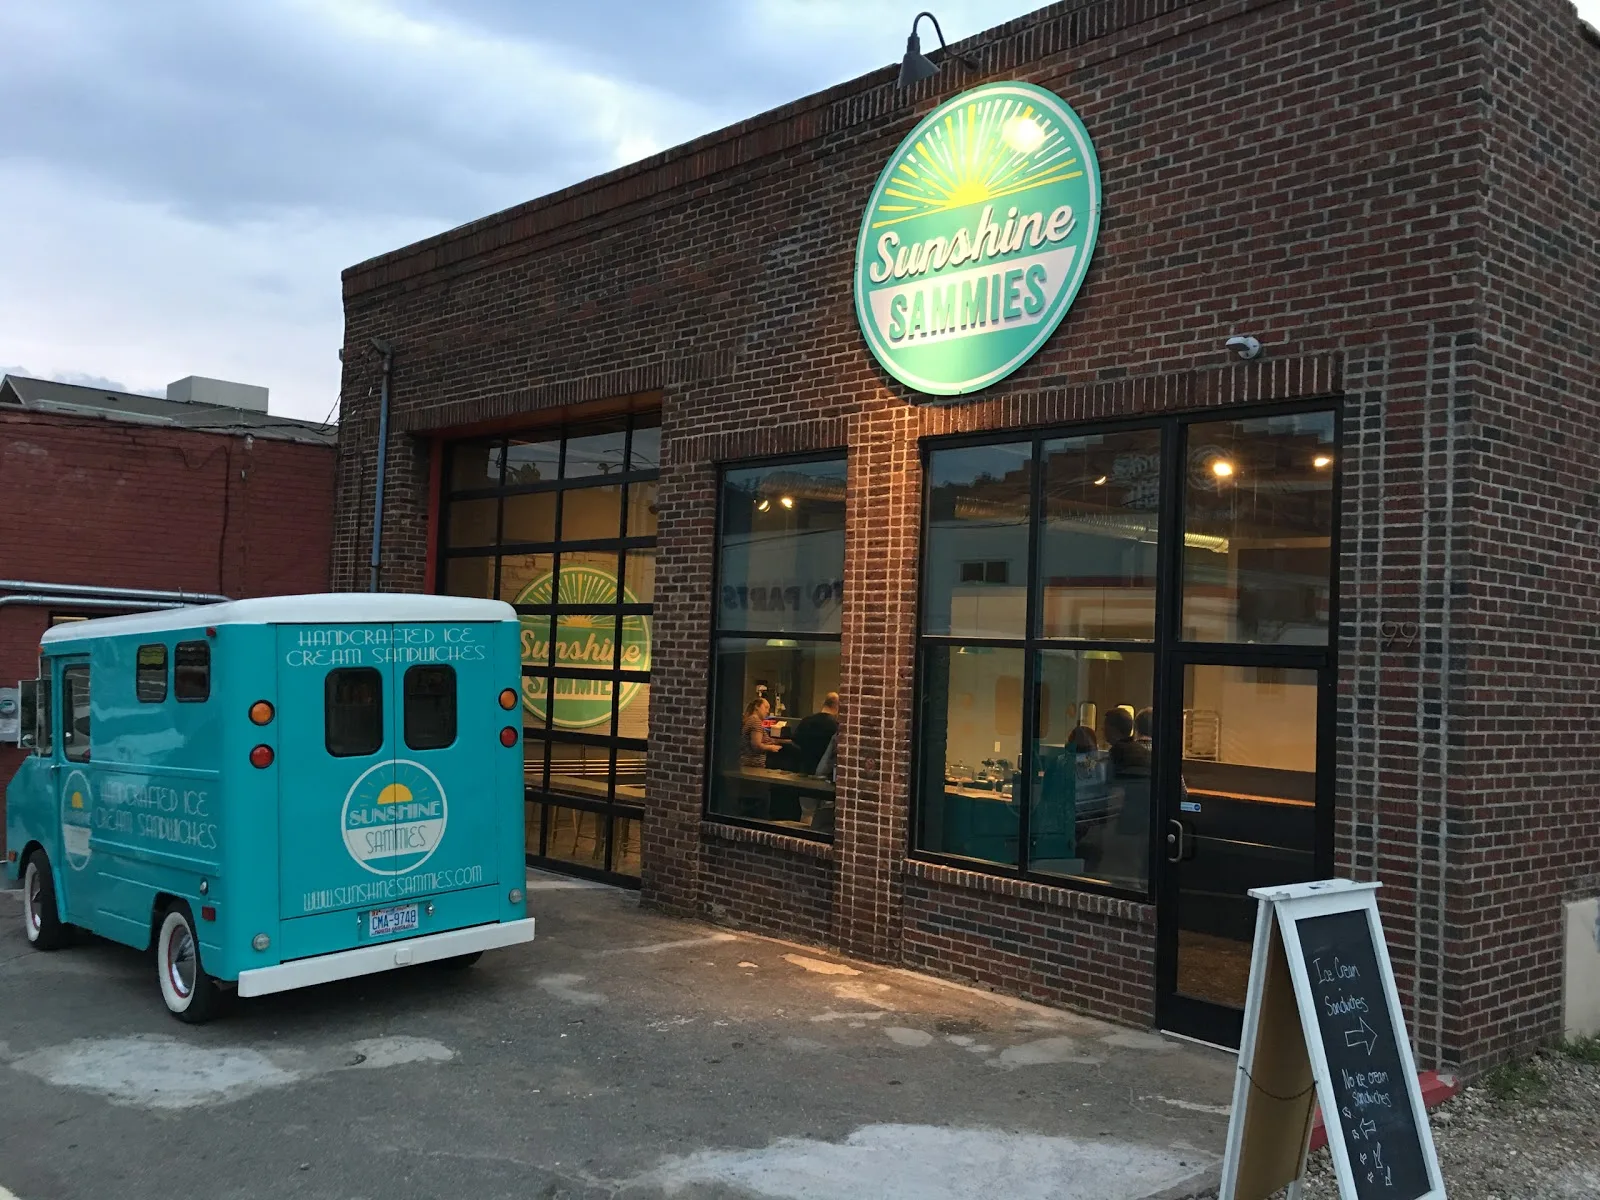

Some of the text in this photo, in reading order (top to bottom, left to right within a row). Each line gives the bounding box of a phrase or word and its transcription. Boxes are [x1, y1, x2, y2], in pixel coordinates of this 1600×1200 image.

[869, 204, 1077, 284] Sunshine
[889, 263, 1047, 342] SAMMIES
[298, 627, 476, 647] HANDCRAFTED ICE
[1380, 620, 1418, 648] 99
[286, 645, 486, 667] CREAM SANDWICHES
[527, 676, 625, 696] SMMIE
[183, 790, 209, 817] ICE
[349, 801, 441, 826] SUNSHINE
[136, 813, 218, 850] SANDWICHES
[365, 824, 427, 855] SAMMIES
[372, 909, 417, 931] CMA-9748
